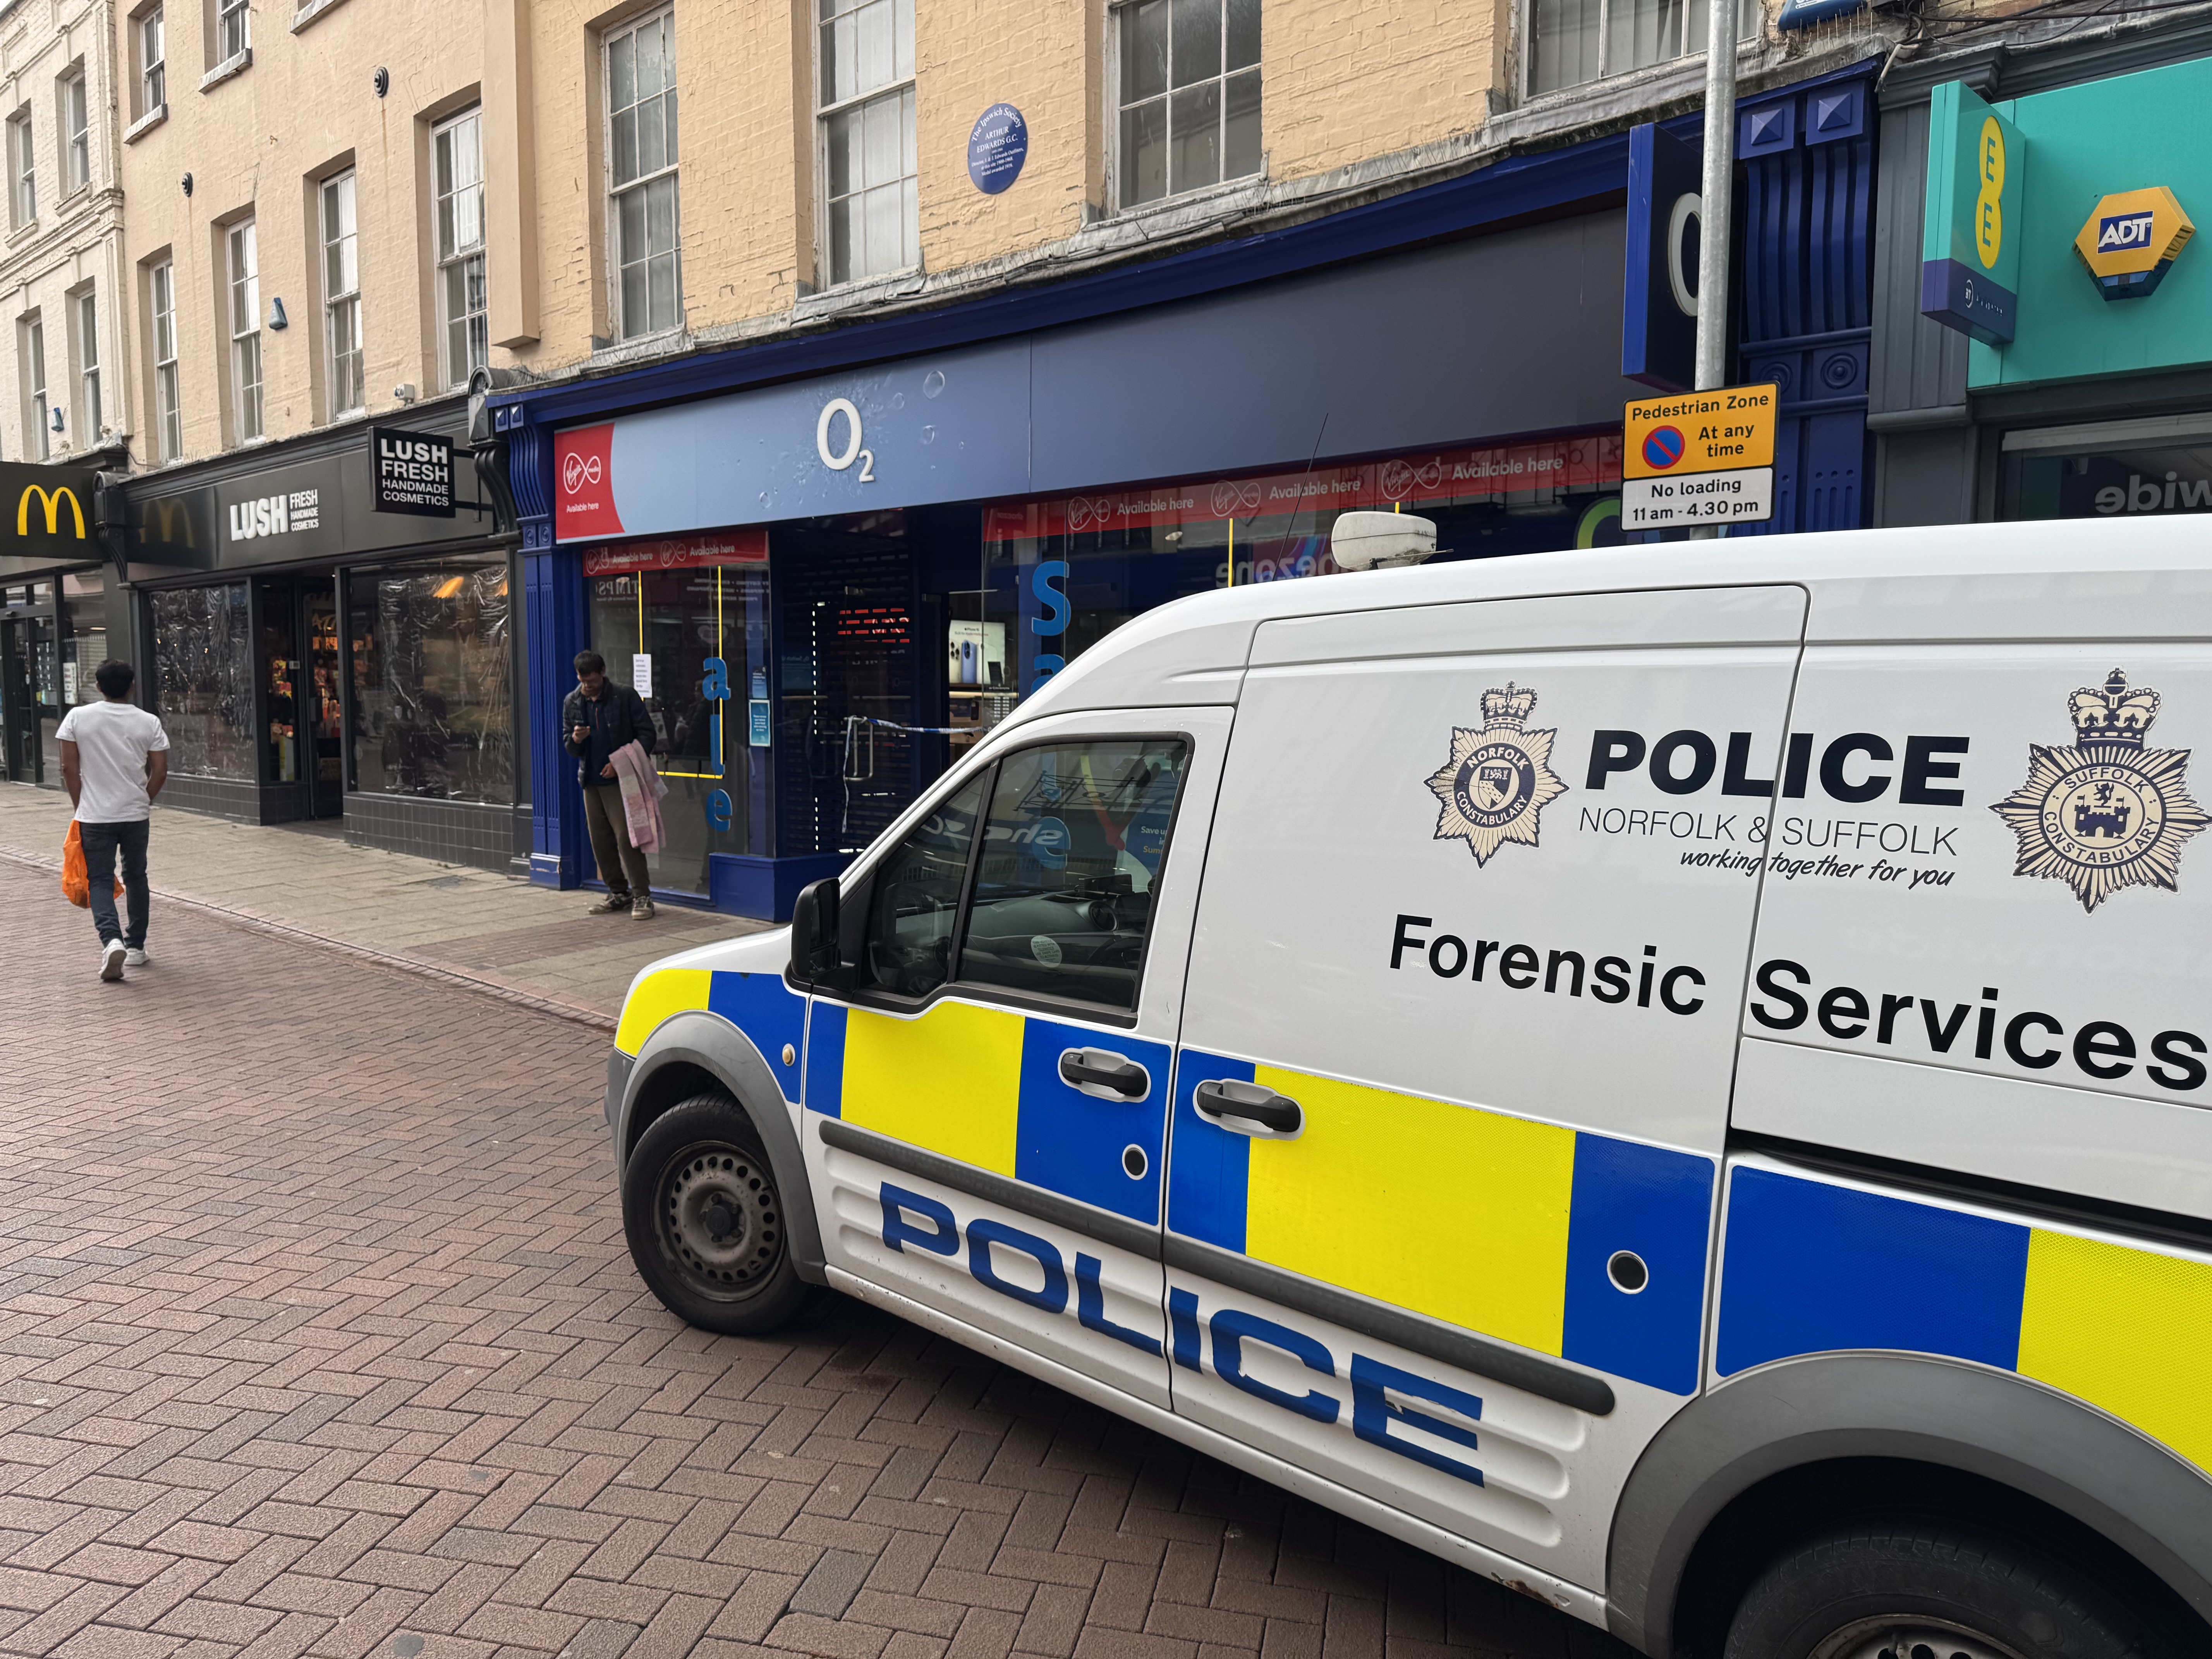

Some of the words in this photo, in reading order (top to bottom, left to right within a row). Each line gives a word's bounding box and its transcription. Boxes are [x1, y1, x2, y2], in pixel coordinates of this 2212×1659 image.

[971, 126, 982, 142] The
[980, 107, 1003, 127] Ipswich
[1003, 107, 1022, 128] Society
[985, 126, 1009, 140] ARTHUR
[977, 137, 1005, 153] EDWARDS
[1982, 136, 1996, 248] EE
[1632, 400, 1720, 421] Pedestrian
[1726, 395, 1769, 410] Zone
[1698, 426, 1718, 440] At
[1724, 425, 1755, 438] any
[381, 438, 448, 464] LUSH
[1707, 443, 1744, 457] time
[381, 460, 448, 483] FRESH
[567, 460, 582, 486] Virgin
[1385, 469, 1411, 493] Virgin
[1452, 459, 1523, 481] Available
[1526, 455, 1563, 471] here
[290, 489, 319, 508] FRESH
[382, 478, 449, 495] HANDMADE
[383, 490, 449, 507] COSMETICS
[1214, 486, 1235, 510] Virgin
[1269, 479, 1328, 500] Available
[1331, 477, 1361, 494] here
[1651, 484, 1673, 498] No
[1680, 479, 1741, 496] loading
[230, 494, 289, 541] LUSH
[290, 507, 318, 521] HANDMADE
[567, 503, 587, 514] Available
[588, 503, 599, 511] here
[1071, 503, 1089, 524] Virgin
[1117, 498, 1167, 516] Available
[1169, 497, 1194, 510] here
[291, 519, 319, 532] COSMETICS
[612, 553, 639, 563] Available
[640, 551, 653, 561] here
[690, 546, 719, 556] Available
[721, 545, 735, 554] here
[1466, 747, 1530, 770] NORFOLK
[1585, 729, 1970, 807] POLICE
[2064, 767, 2151, 793] SUFFOLK
[1456, 791, 1528, 825] CONSTABULARY
[1141, 826, 1159, 835] Save
[1579, 807, 1738, 842] NORFOLK
[1747, 816, 1769, 843] &
[1781, 817, 1960, 857] SUFFOLK
[2044, 811, 2160, 864] CONSTABULARY
[1680, 847, 1763, 878] working
[1767, 851, 1864, 881] together
[1866, 858, 1907, 883] for
[1907, 866, 1956, 890] you
[1388, 914, 1707, 1016] Forensic
[1750, 958, 2209, 1091] Services
[879, 1181, 1486, 1489] POLICE
